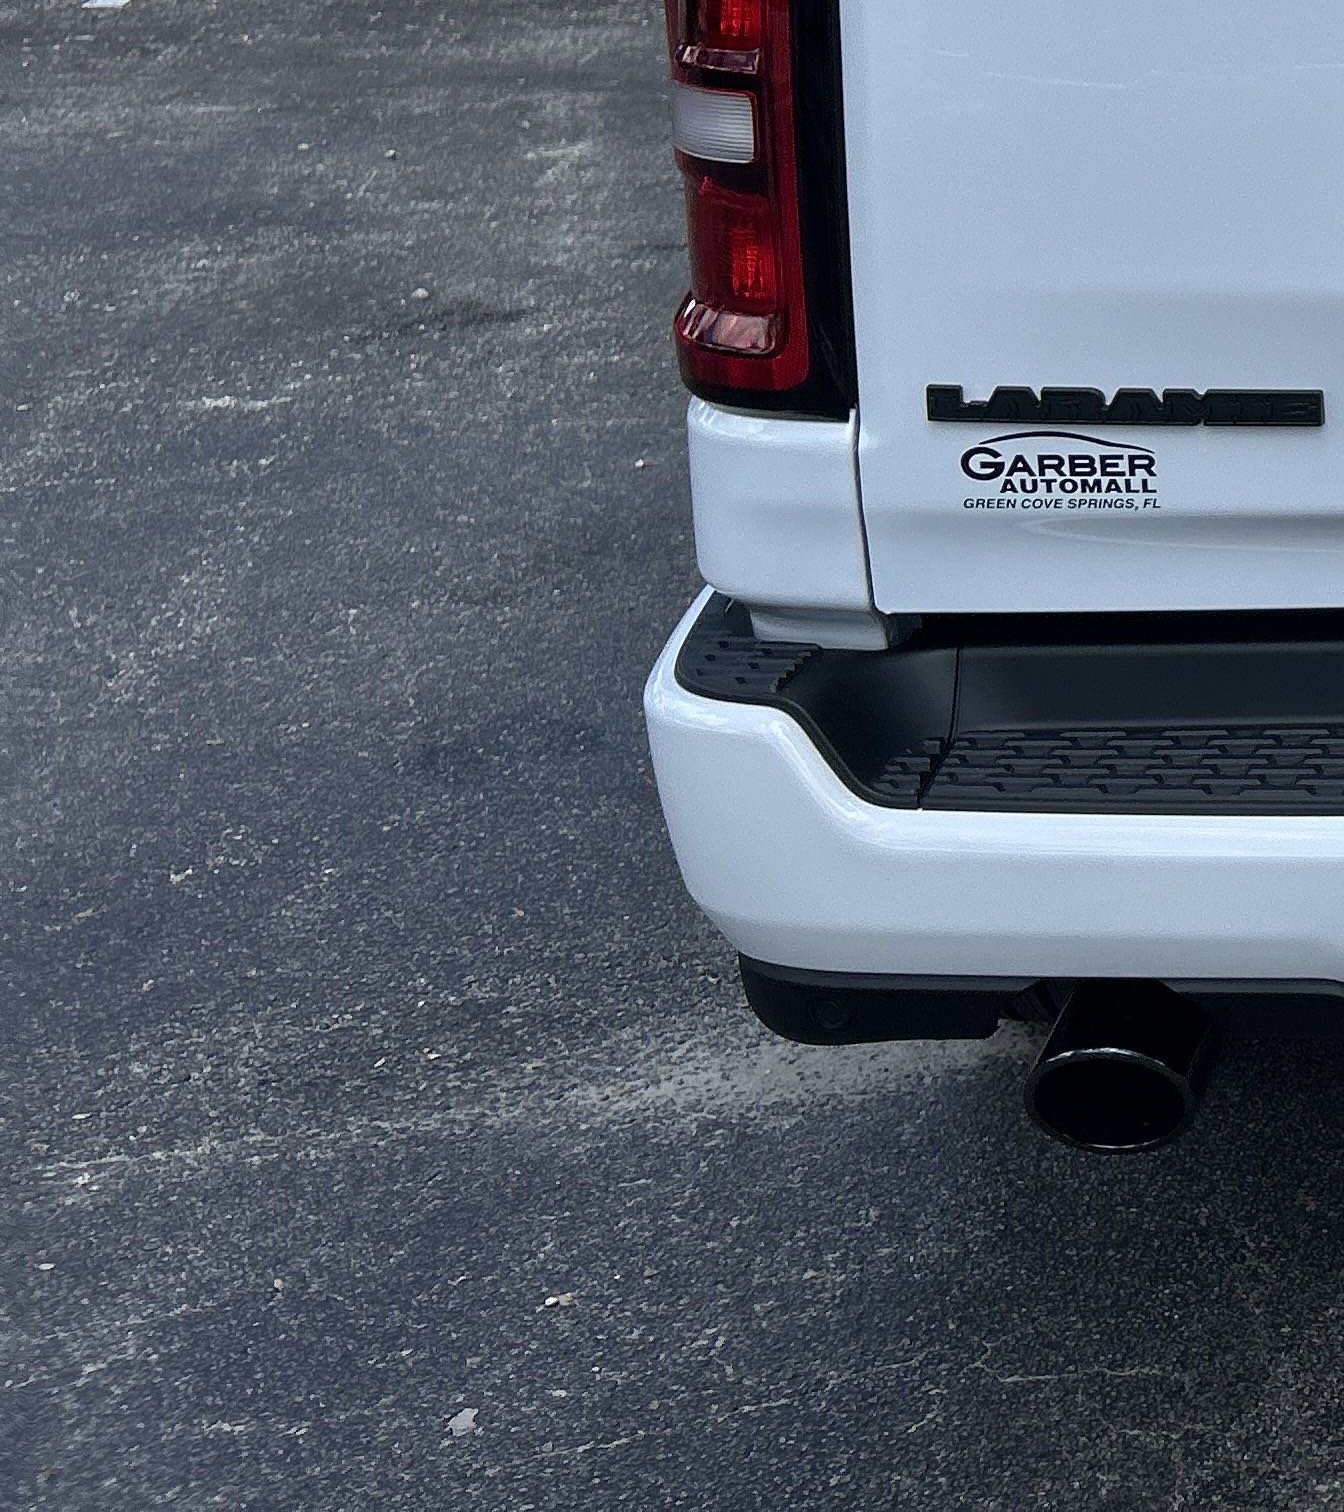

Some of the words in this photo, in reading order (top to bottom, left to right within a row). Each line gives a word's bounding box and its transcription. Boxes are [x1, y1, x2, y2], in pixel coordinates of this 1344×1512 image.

[960, 446, 1157, 481] GARBER
[999, 478, 1158, 494] AUTOMALL
[963, 498, 1017, 510] GREEN
[1020, 498, 1064, 510] COVE
[1067, 497, 1139, 511] SPRINGS,
[1142, 498, 1162, 509] FL
